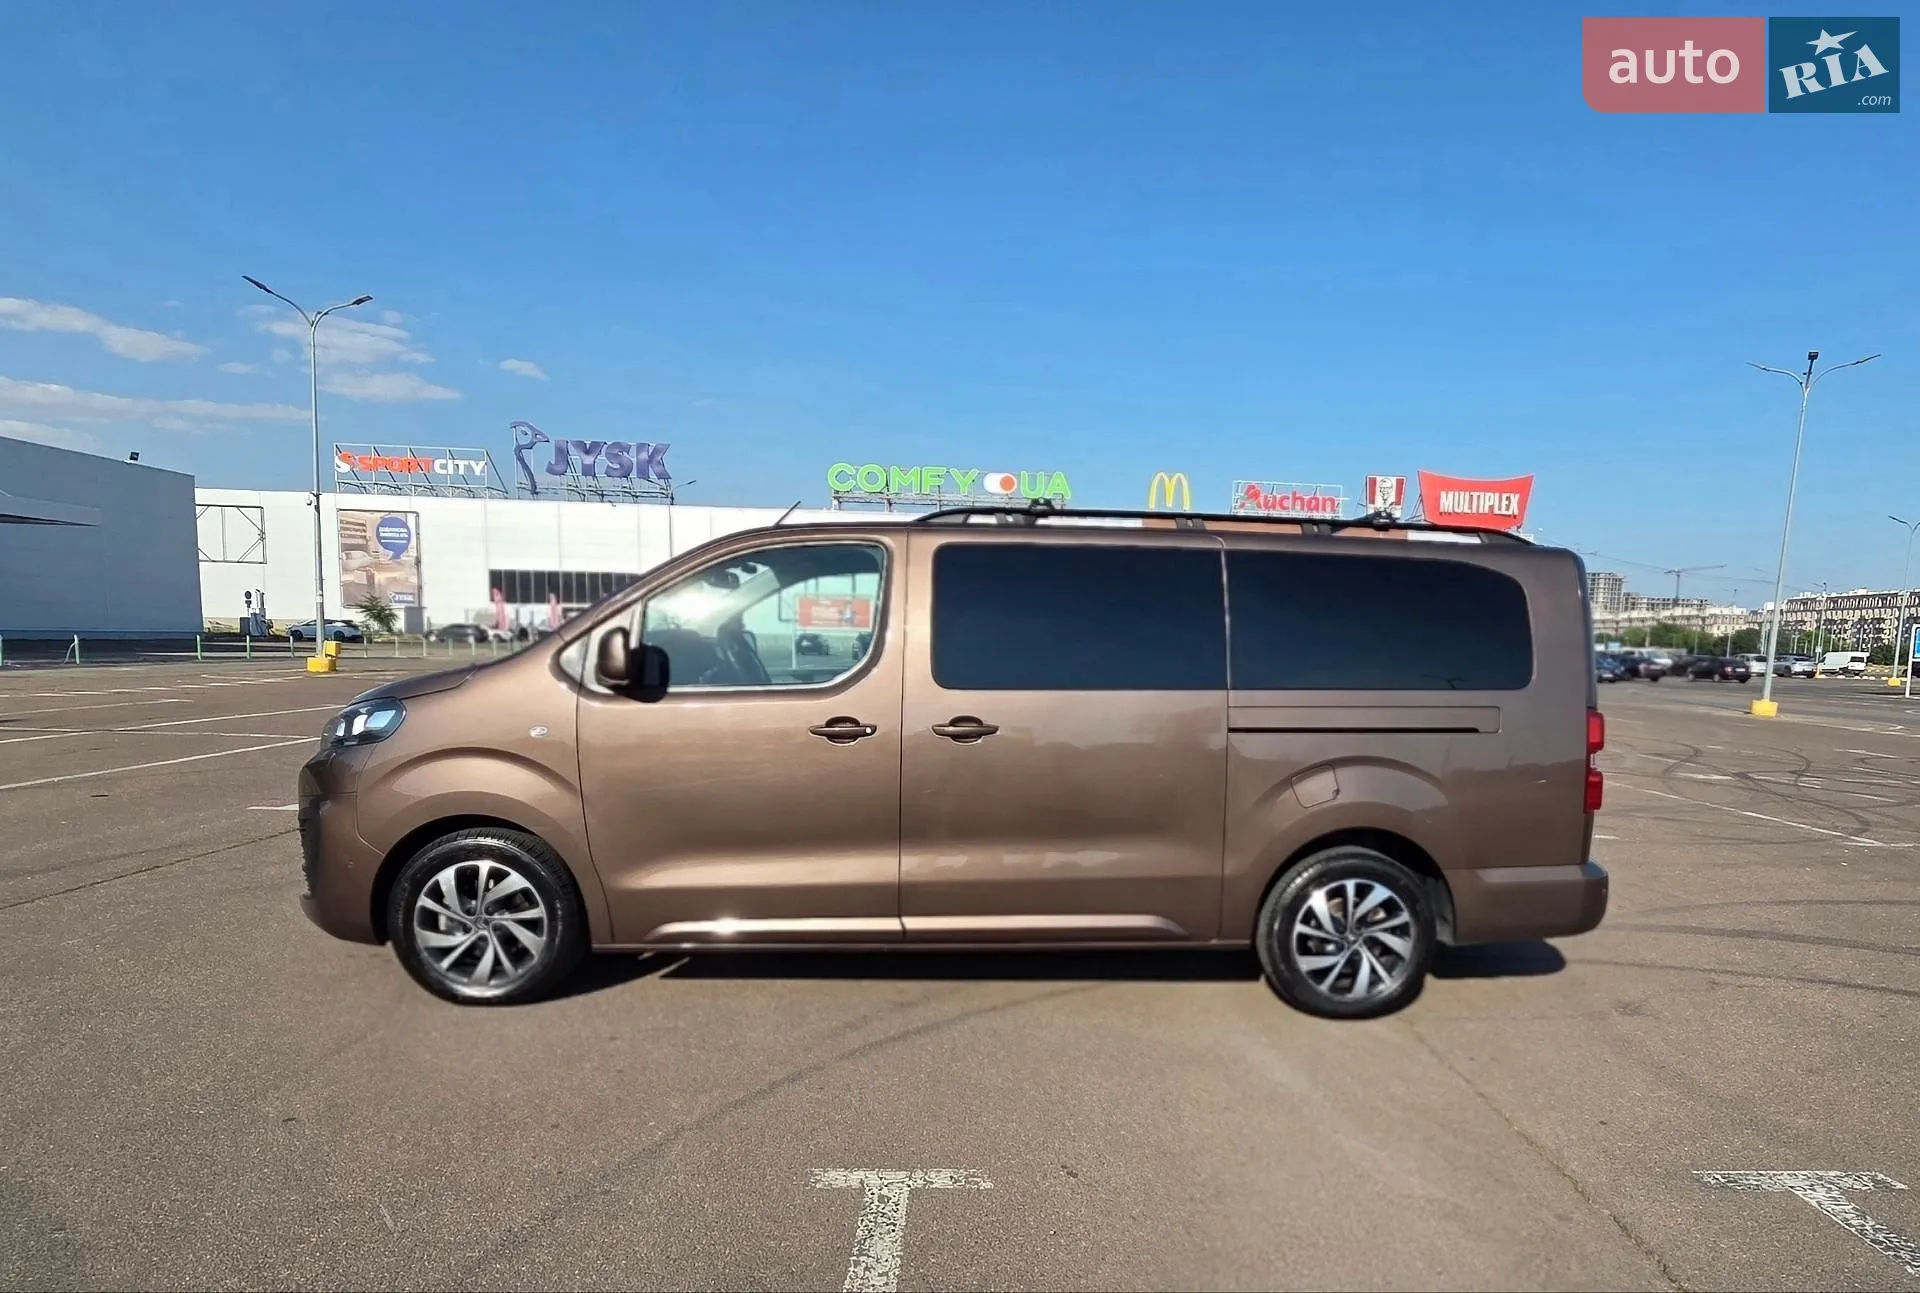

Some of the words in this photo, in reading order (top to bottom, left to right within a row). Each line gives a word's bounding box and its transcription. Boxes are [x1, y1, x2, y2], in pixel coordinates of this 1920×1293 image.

[545, 439, 672, 480] JYSK
[827, 462, 979, 495] COMFY
[1020, 470, 1071, 500] UA
[1239, 484, 1337, 513] Auchan
[1439, 490, 1520, 516] MULTIPLEX
